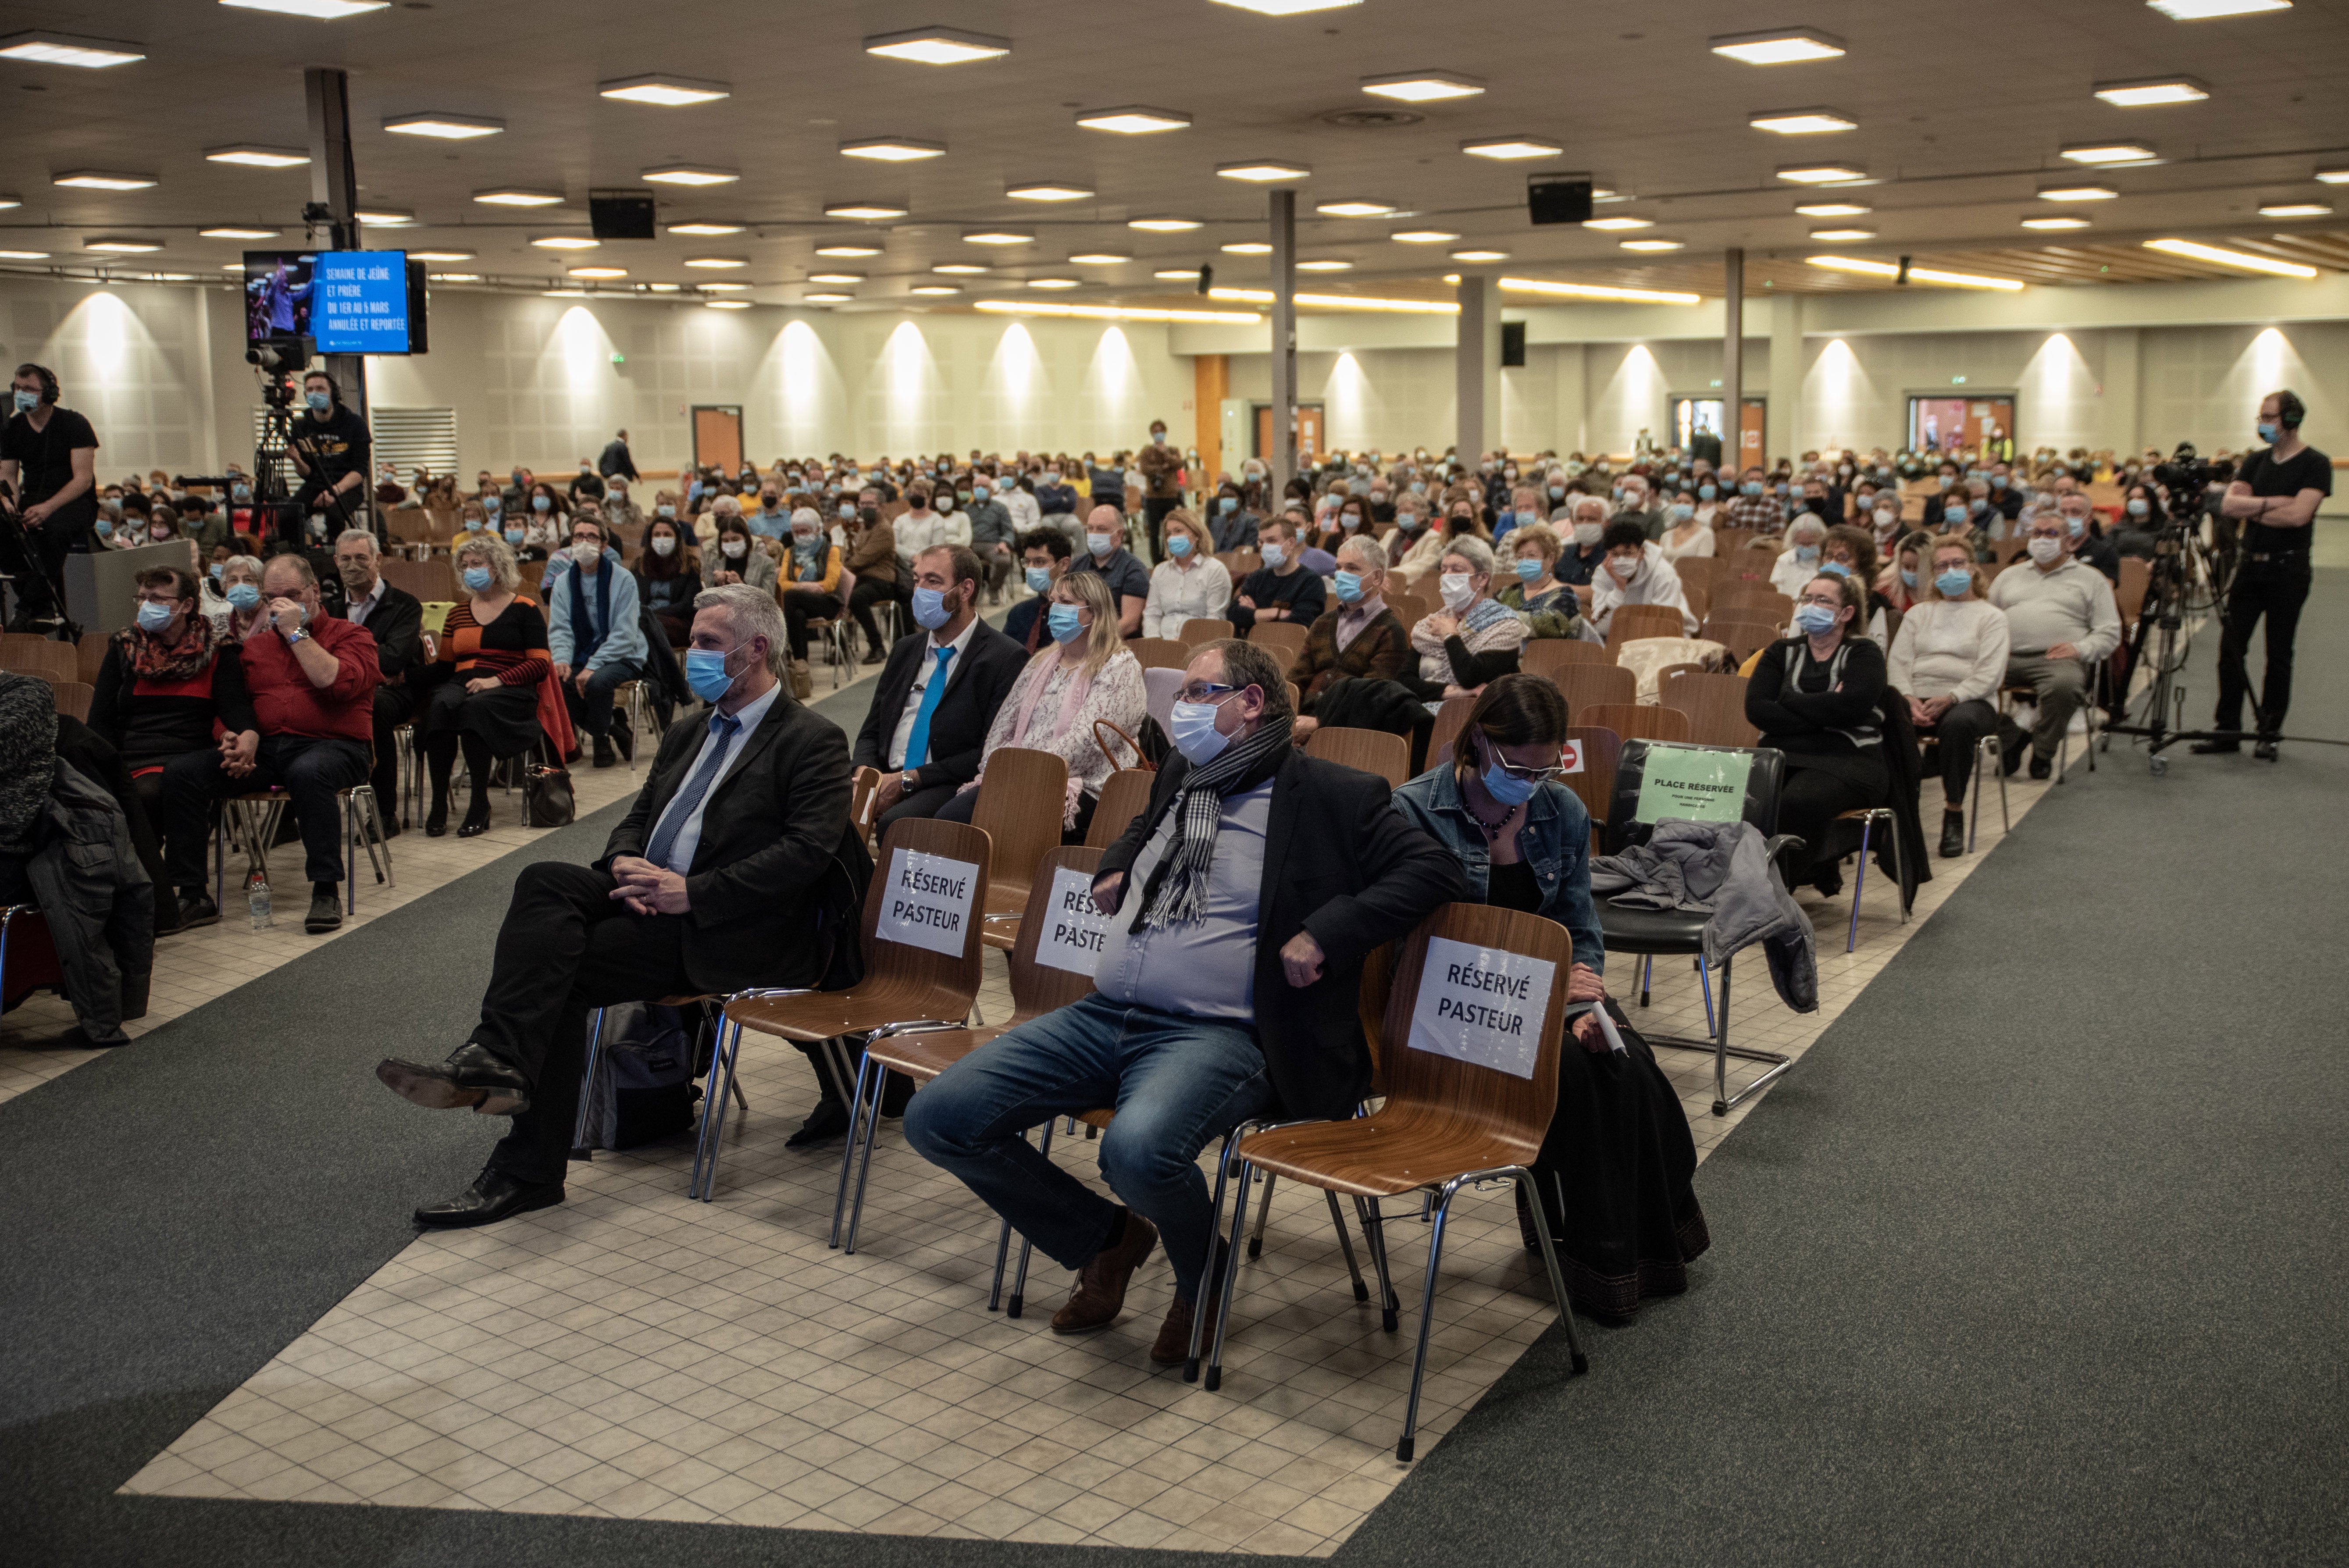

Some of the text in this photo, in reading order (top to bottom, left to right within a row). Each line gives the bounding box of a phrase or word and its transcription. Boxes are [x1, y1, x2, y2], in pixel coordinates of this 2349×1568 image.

[326, 265, 389, 280] SEMAINE DE JEÛNE
[327, 282, 361, 297] ET PRIÈRE
[327, 301, 389, 314] DU 1ER AU 5 MARS
[328, 316, 405, 331] ANNULÉE ET REPORTÉE
[1654, 779, 1734, 793] PLACE RÉSERVÉE
[901, 868, 966, 899] RÉSERVÉ
[893, 900, 959, 932] PASTEUR
[1447, 962, 1530, 1000] RÉSERVÉ
[1438, 998, 1522, 1035] PASTEUR
